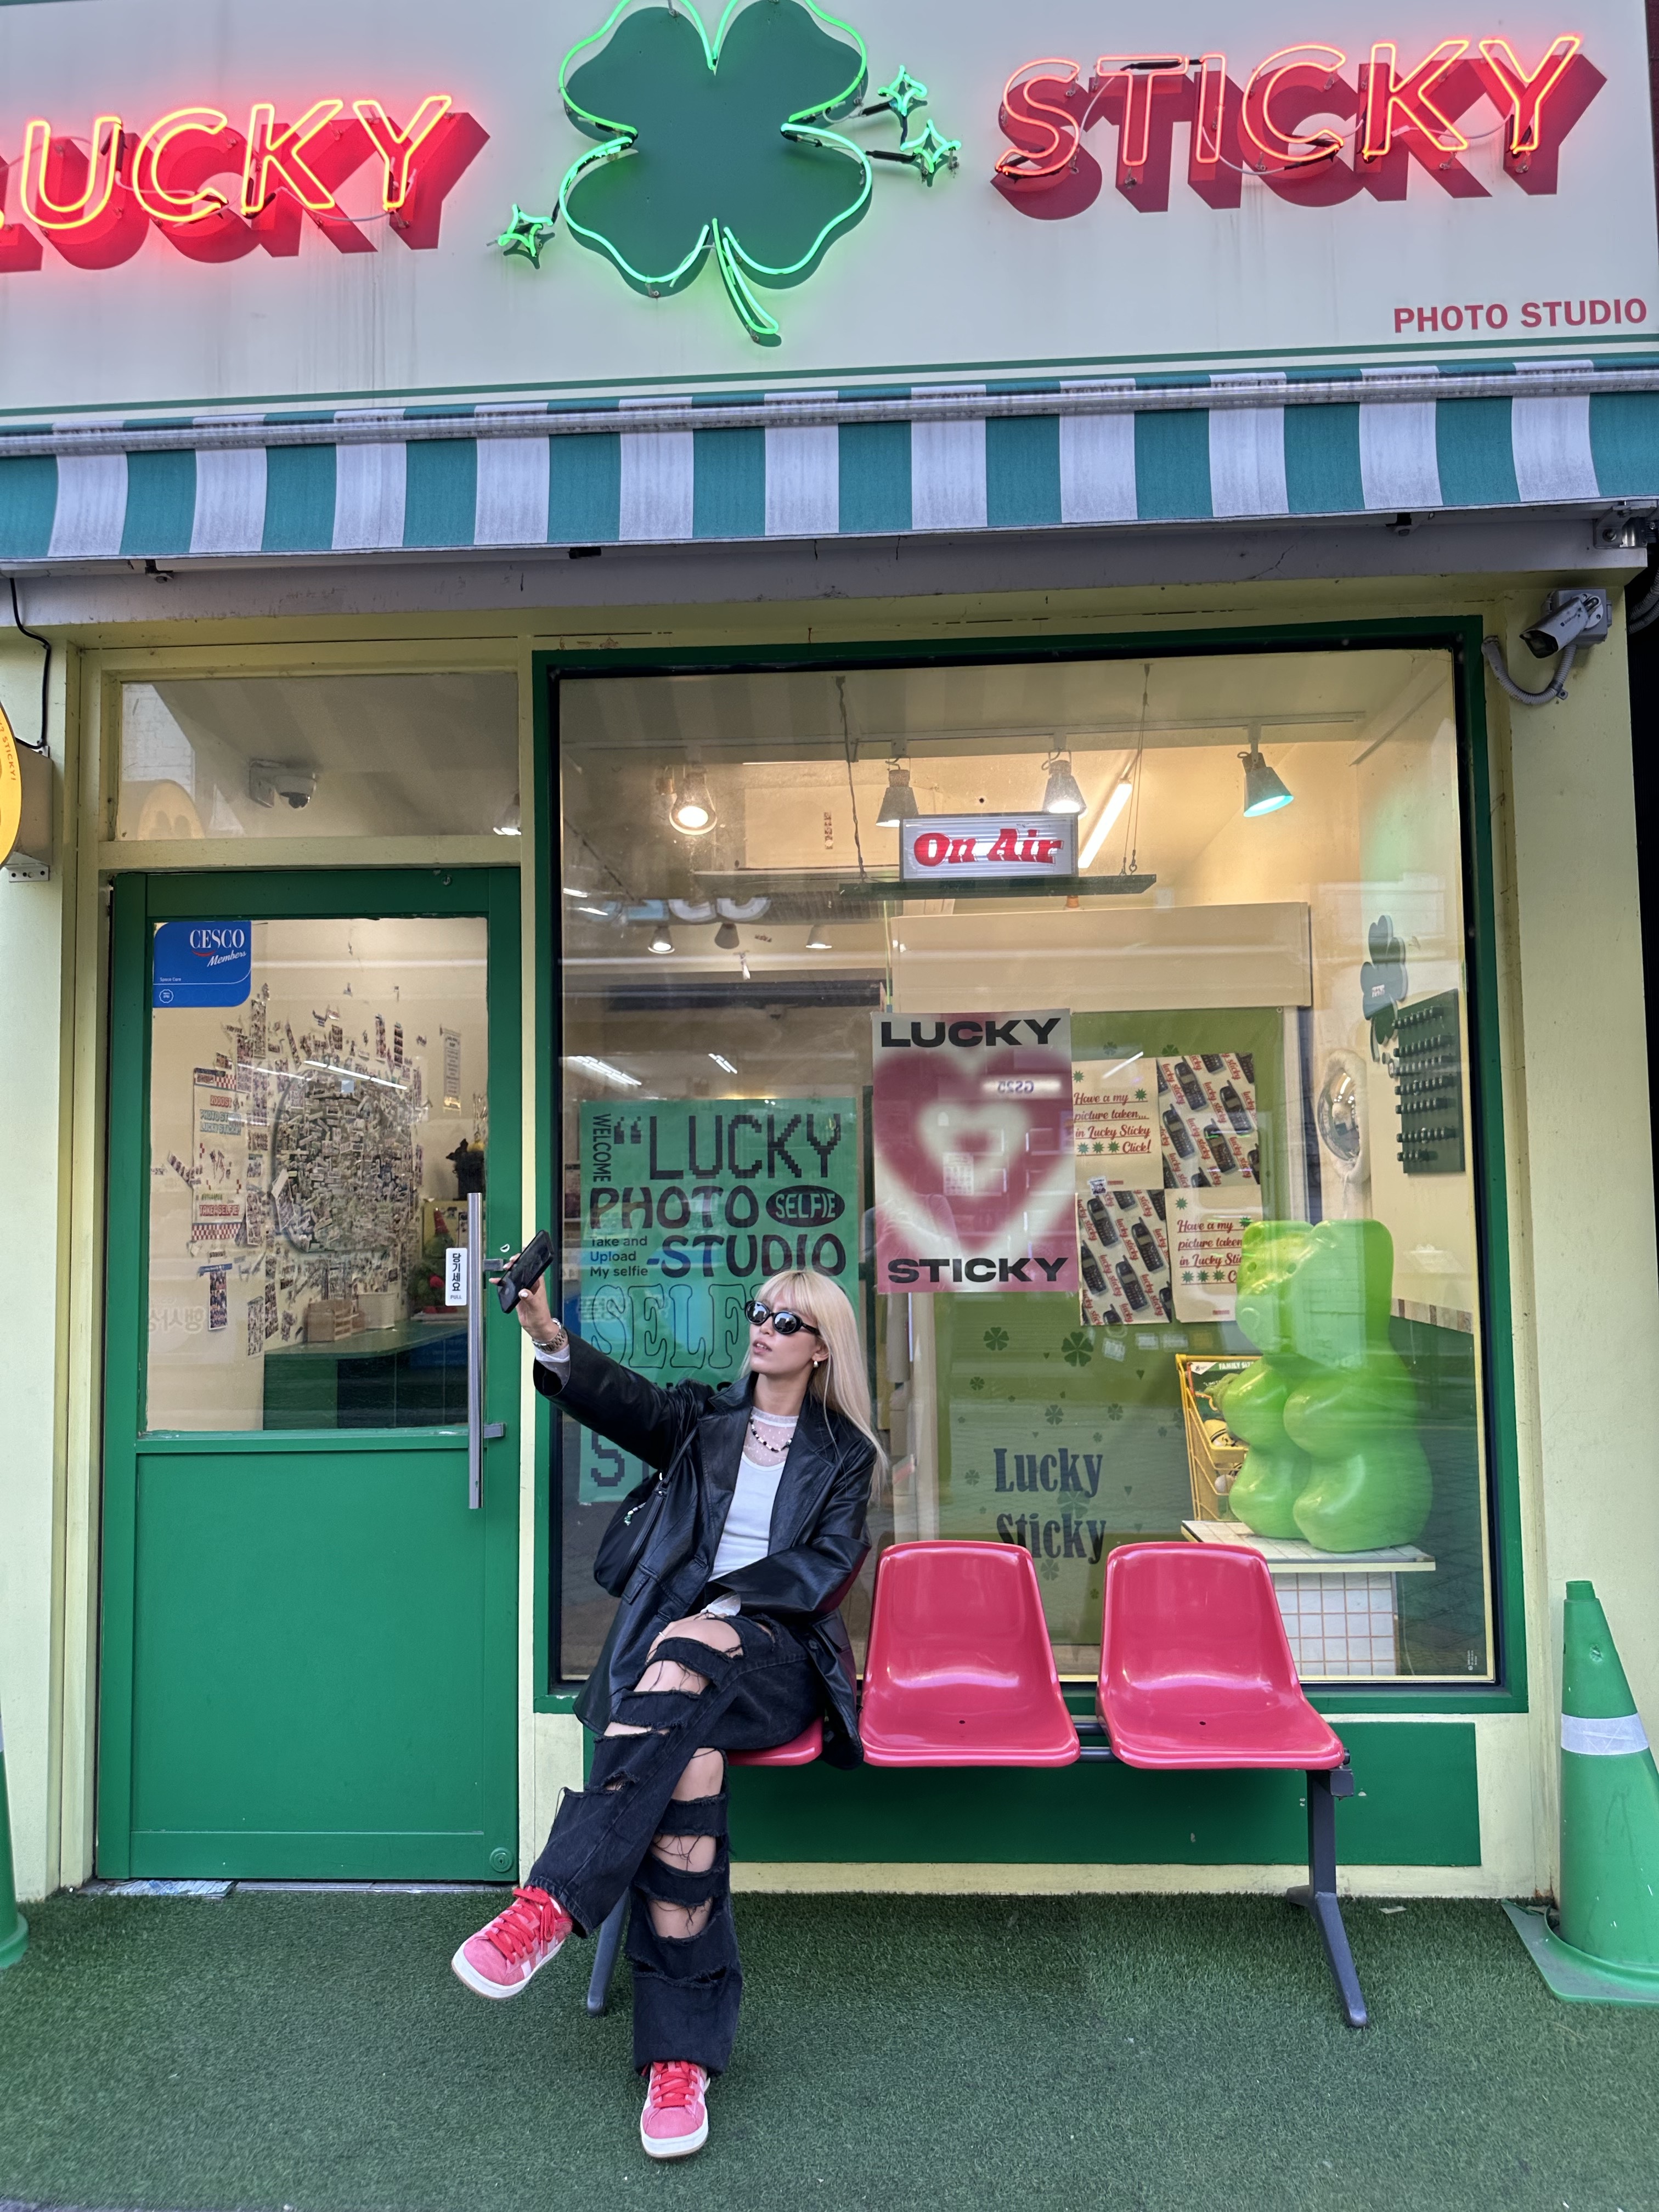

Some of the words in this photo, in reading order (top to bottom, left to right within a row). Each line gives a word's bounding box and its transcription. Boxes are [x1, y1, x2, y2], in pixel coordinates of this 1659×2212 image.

[991, 36, 1594, 211] STICKY
[1393, 305, 1508, 334] PHOTO
[1520, 298, 1647, 328] STUDIO
[913, 832, 978, 867] On
[987, 828, 1065, 865] Air
[189, 929, 245, 949] CESCO
[206, 950, 247, 967] Members
[881, 1018, 1062, 1047] LUCKY
[1073, 1092, 1101, 1105] Have
[1113, 1094, 1129, 1106] my
[1074, 1110, 1109, 1124] picture
[1075, 1127, 1085, 1138] in
[1088, 1125, 1118, 1141] Lucky
[1119, 1124, 1151, 1139] Sticky
[592, 1113, 612, 1183] WELCOME
[1122, 1138, 1152, 1154] Click!
[590, 1185, 759, 1229] PHOTO
[775, 1192, 837, 1219] SELFIE
[1177, 1219, 1205, 1233] Have
[1217, 1221, 1233, 1234] my
[591, 1236, 619, 1246] Take
[623, 1235, 648, 1246] and
[1178, 1238, 1214, 1252] picture
[590, 1250, 637, 1265] Upload
[1180, 1256, 1189, 1266] in
[1192, 1254, 1222, 1269] Lucky
[452, 1252, 462, 1292] 당기세요
[590, 1265, 610, 1279] My
[613, 1265, 648, 1277] selfie
[888, 1256, 1069, 1284] STICKY
[591, 1283, 765, 1372] SELF
[993, 1448, 1103, 1498] Lucky
[996, 1512, 1107, 1565] Sticky
